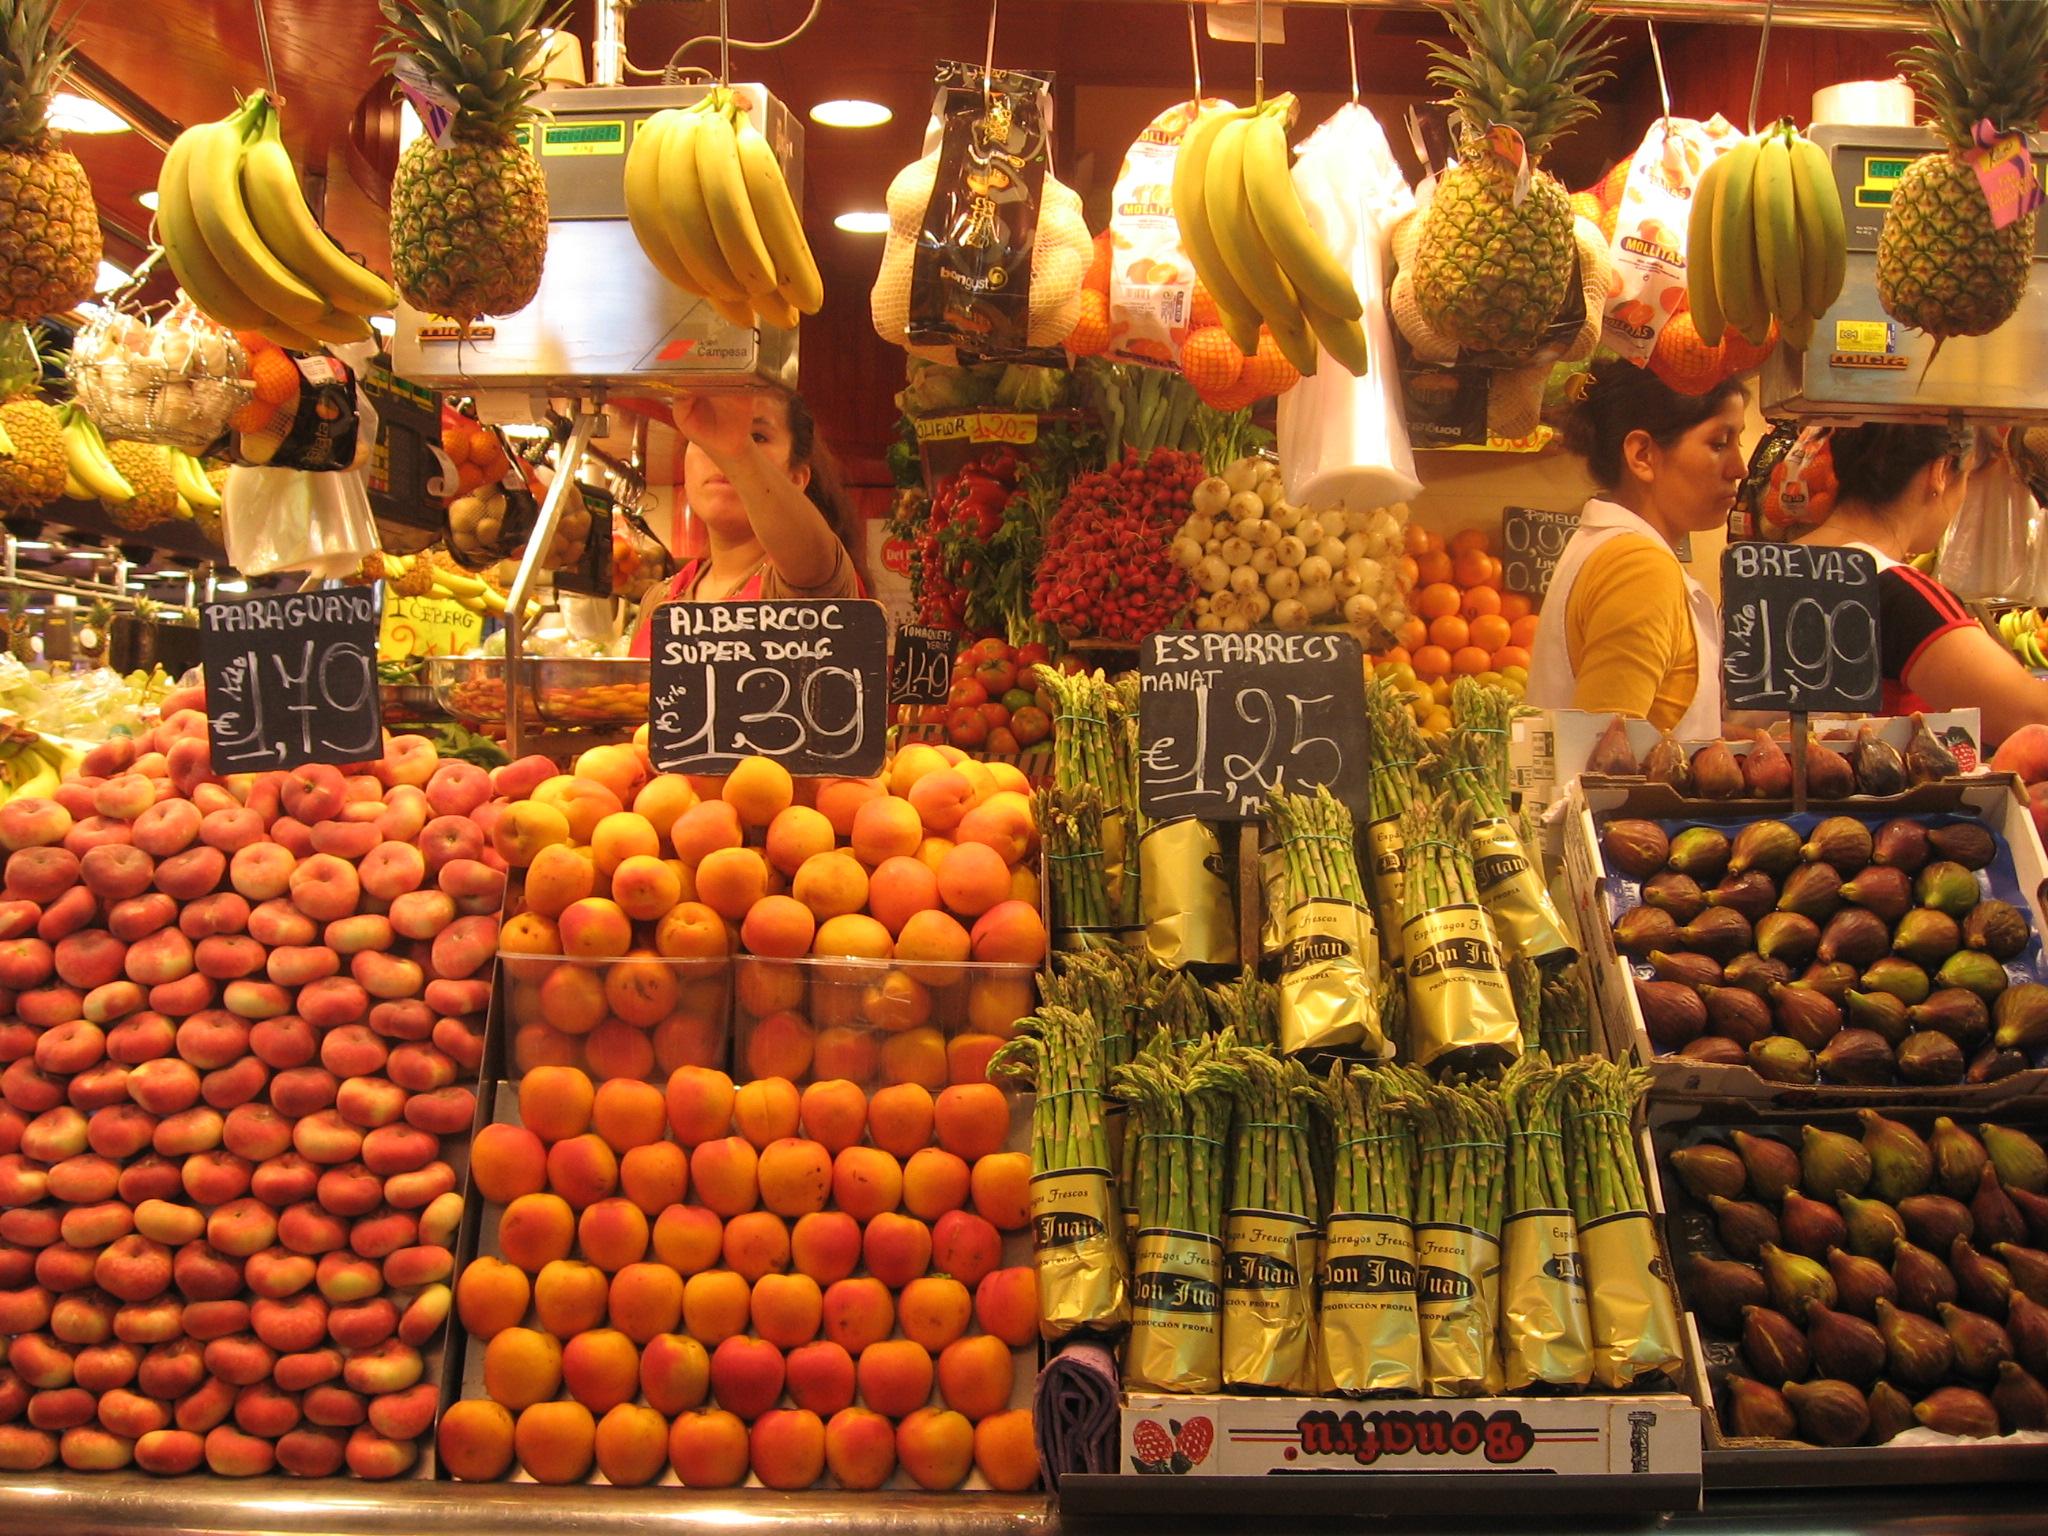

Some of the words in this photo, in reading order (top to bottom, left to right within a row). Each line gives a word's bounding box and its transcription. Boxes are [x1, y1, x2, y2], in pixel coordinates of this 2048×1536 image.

[1123, 203, 1175, 217] MOLLITA
[1625, 238, 1685, 266] MOLLITAS
[940, 266, 989, 292] bongust
[697, 346, 748, 358] Campesa
[1524, 509, 1581, 527] POMELO
[1536, 557, 1557, 569] LIM
[1732, 544, 1868, 586] BREVAS
[1506, 561, 1554, 595] 0,8
[205, 594, 373, 633] PARAGUAYO
[669, 604, 844, 636] ALBERCOC
[661, 641, 757, 666] SUPER
[1153, 632, 1341, 666] ESPARRECS
[1728, 597, 1881, 704] 1,99
[1141, 669, 1224, 693] MANAT
[1475, 857, 1526, 887] Juan
[1291, 940, 1343, 967] Juan
[1415, 947, 1458, 975] Don
[1047, 1188, 1088, 1203] Frescos
[1041, 1215, 1095, 1245] Juan
[1249, 1228, 1293, 1244] Frescos
[1329, 1234, 1371, 1247] árragos
[1140, 1249, 1180, 1264] árragos
[1423, 1241, 1465, 1256] Frescos
[1239, 1256, 1295, 1286] Juan
[1367, 1259, 1416, 1287] Jua
[1170, 1279, 1218, 1307] Jua
[1249, 1300, 1280, 1309] PROPIA
[1380, 1304, 1414, 1313] PROPIA
[1299, 1411, 1532, 1464] Bonafru
